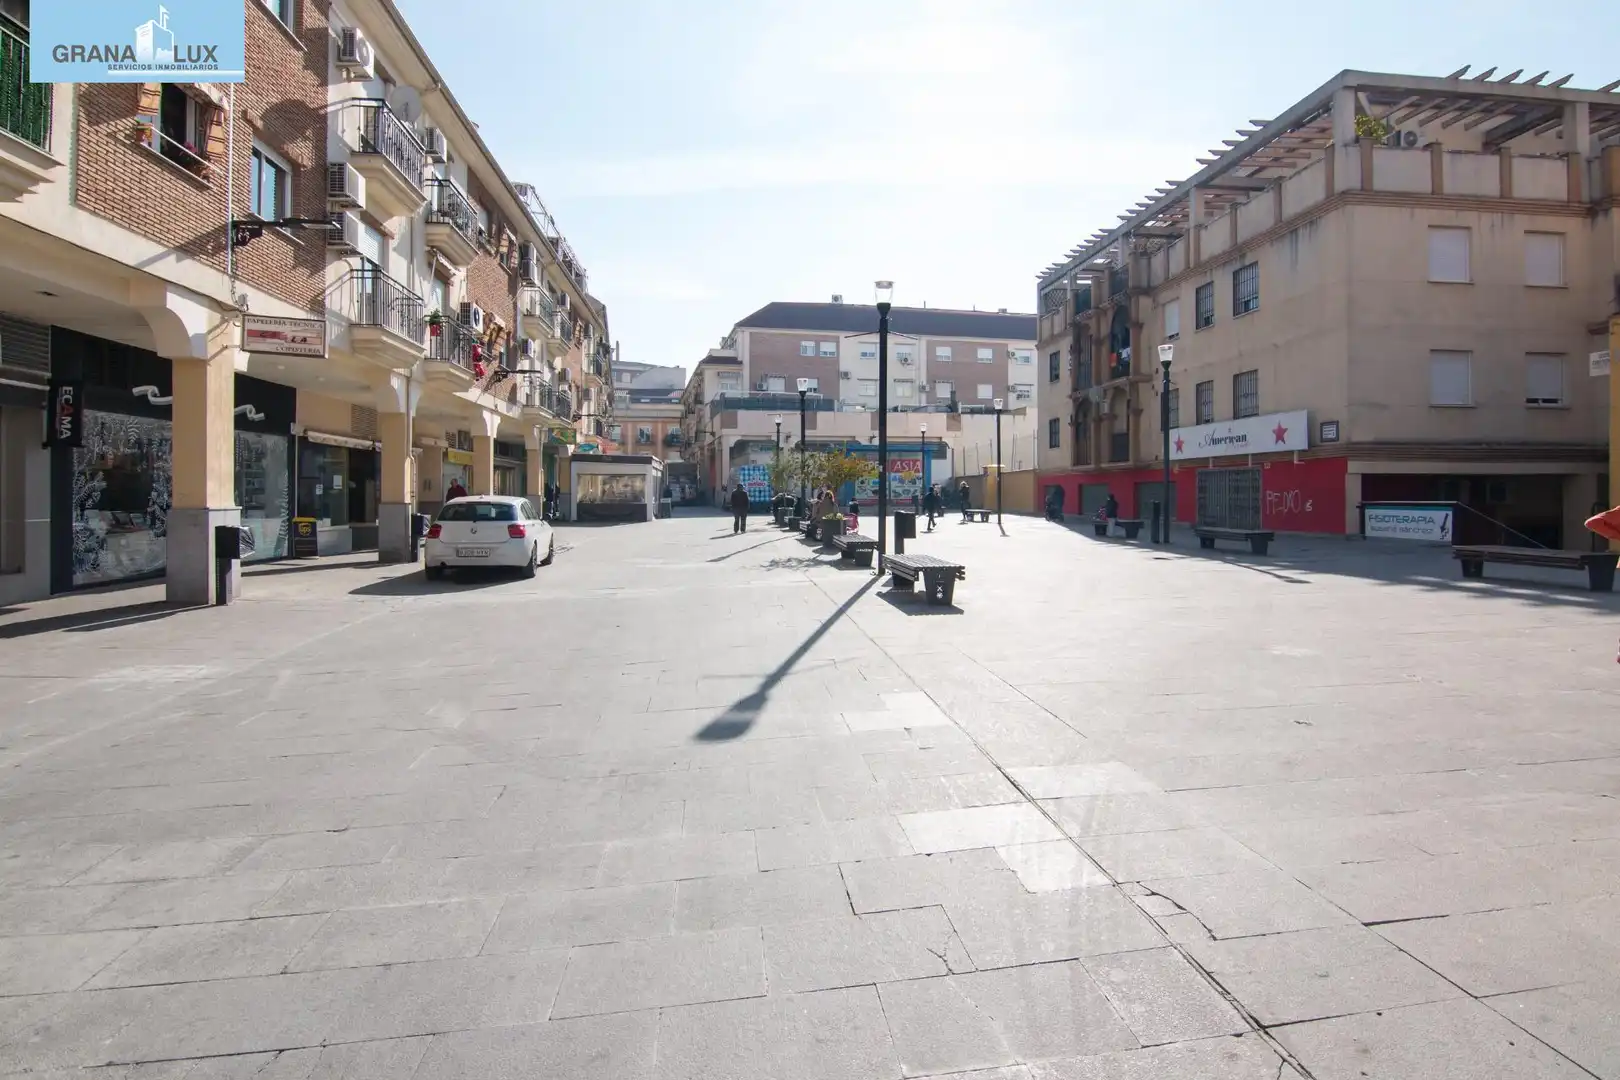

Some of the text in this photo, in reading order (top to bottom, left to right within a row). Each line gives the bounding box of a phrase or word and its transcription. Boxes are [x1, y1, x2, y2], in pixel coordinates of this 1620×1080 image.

[60, 386, 74, 439] ECAMA
[1198, 428, 1247, 448] American
[893, 460, 921, 473] ASIA
[1368, 514, 1436, 524] FISIOTERAPIA
